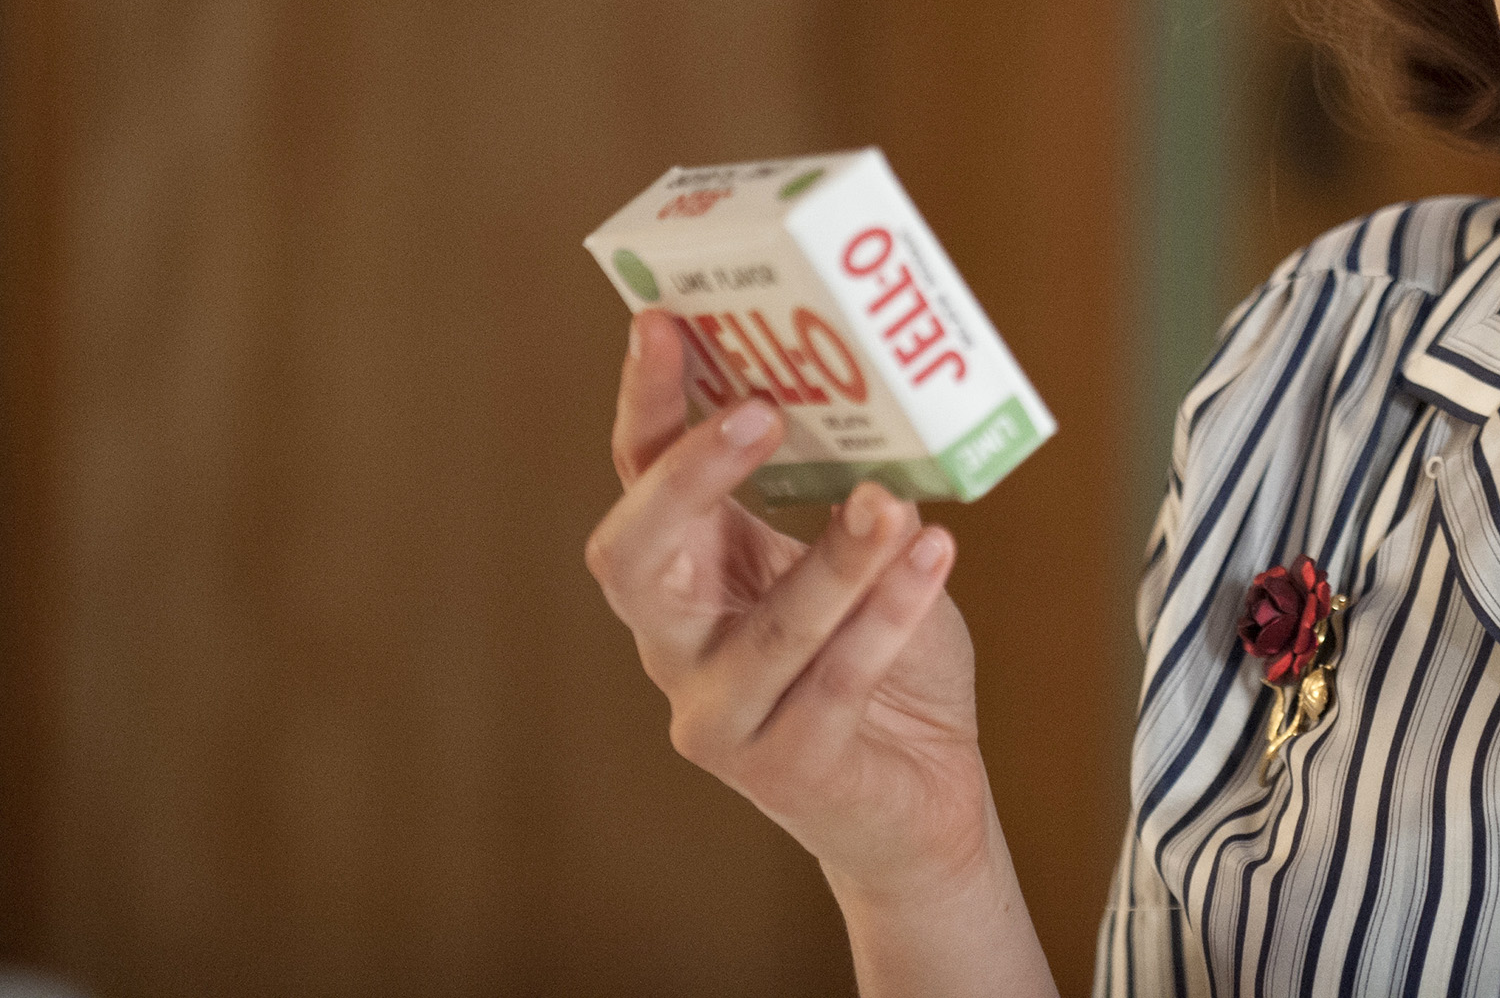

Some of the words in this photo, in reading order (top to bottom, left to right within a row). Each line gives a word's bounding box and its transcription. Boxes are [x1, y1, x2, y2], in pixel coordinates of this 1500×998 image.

[841, 226, 967, 386] JELL-O
[673, 307, 868, 406] JELL-O
[954, 415, 1017, 475] LIME
